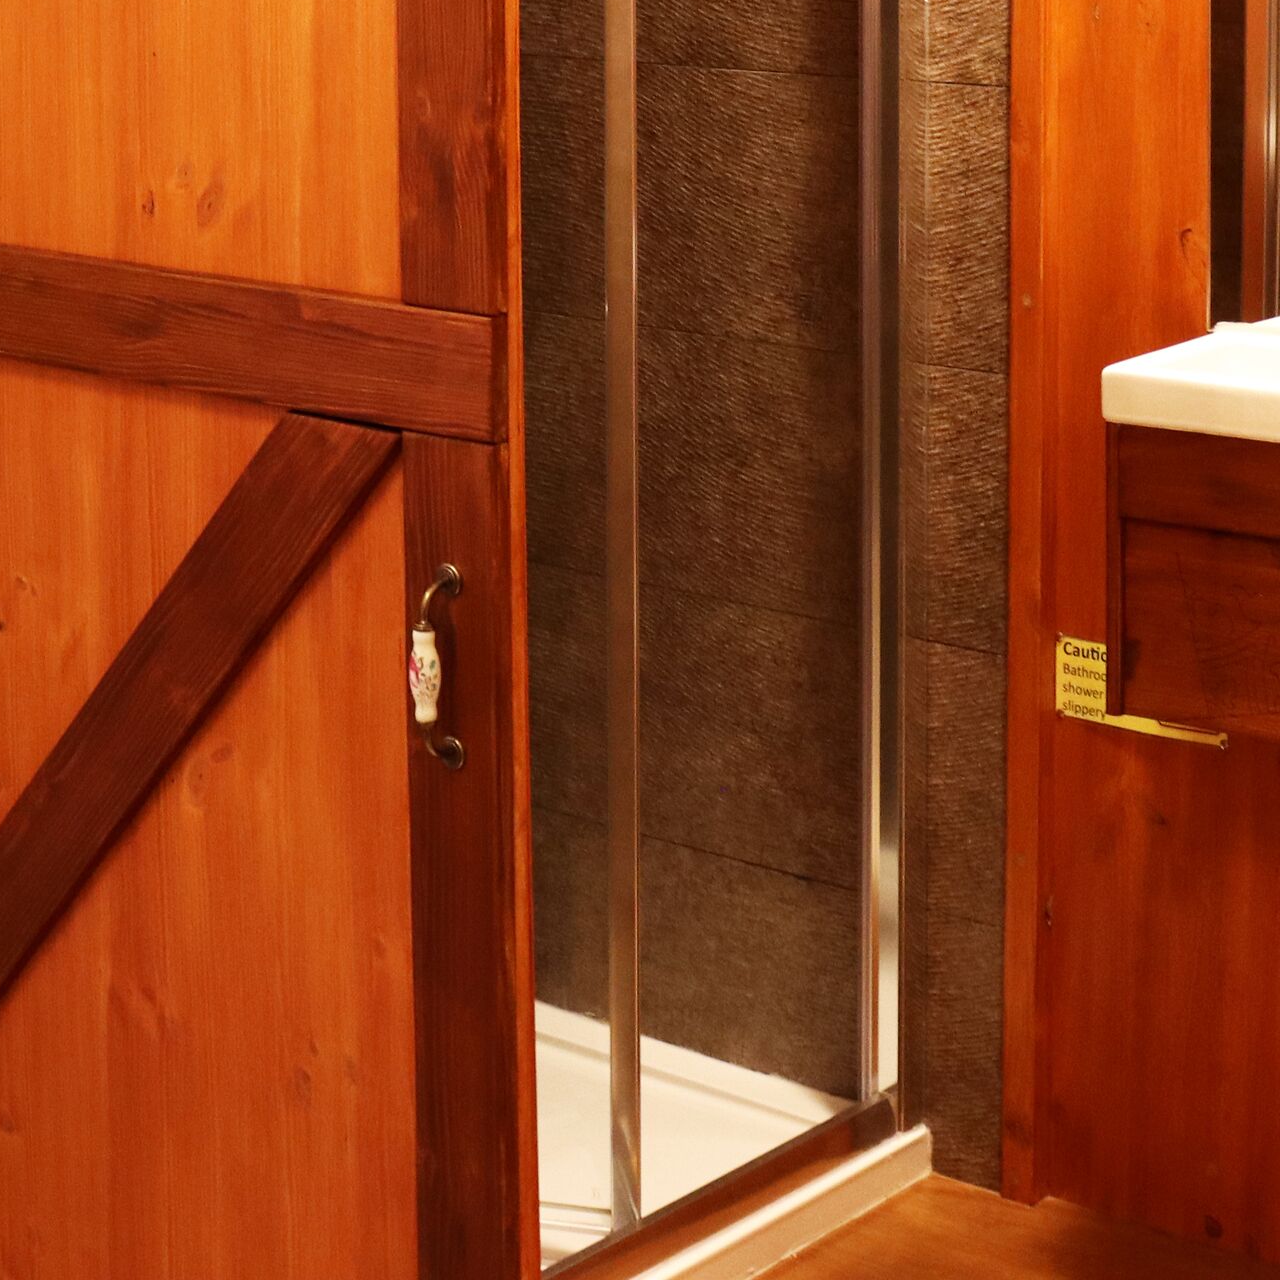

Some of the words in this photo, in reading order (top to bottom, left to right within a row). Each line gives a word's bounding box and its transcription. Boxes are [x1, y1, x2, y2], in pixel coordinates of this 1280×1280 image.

[1063, 641, 1107, 662] Cautio
[1063, 663, 1107, 682] Bathroo
[1062, 681, 1104, 699] shower
[1062, 699, 1106, 721] slippery
